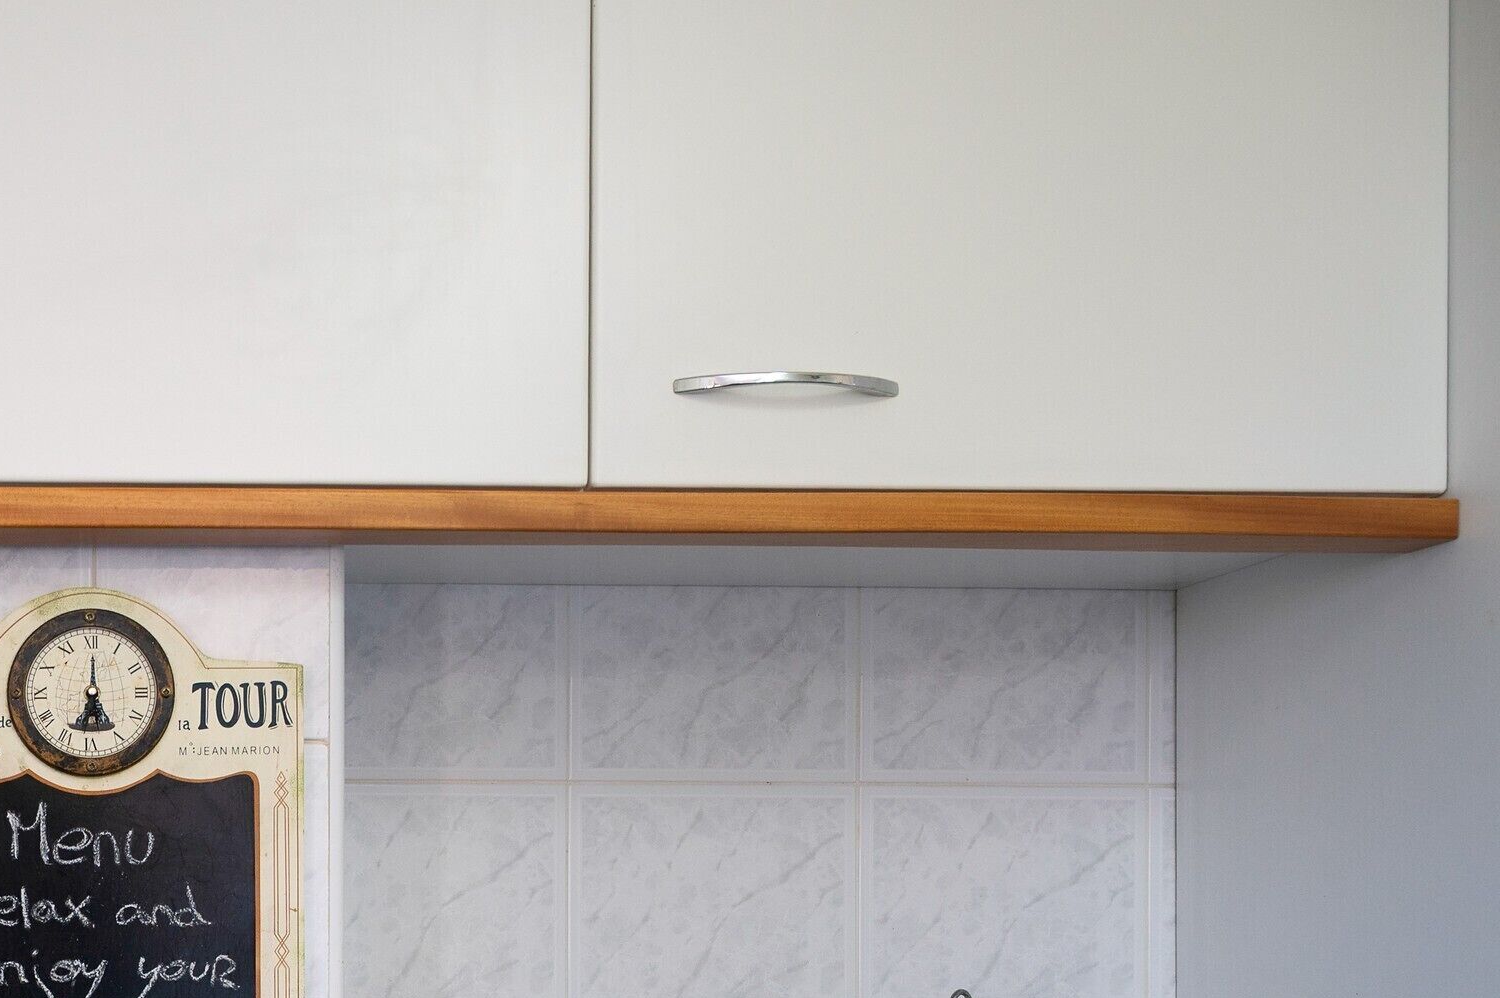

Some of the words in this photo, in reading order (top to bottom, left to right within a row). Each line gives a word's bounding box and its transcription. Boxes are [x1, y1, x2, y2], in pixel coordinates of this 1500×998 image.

[58, 640, 74, 658] XI
[84, 635, 98, 649] XII
[113, 643, 121, 655] I
[39, 661, 55, 676] X
[128, 662, 142, 675] II
[34, 686, 47, 700] IX
[135, 687, 148, 699] III
[178, 720, 190, 730] la
[192, 680, 293, 730] TOUR
[85, 738, 97, 751] VI
[113, 731, 125, 745] V
[197, 746, 228, 755] JEAN
[231, 746, 280, 755] MARION
[6, 802, 155, 866] Menu
[115, 882, 212, 926] and
